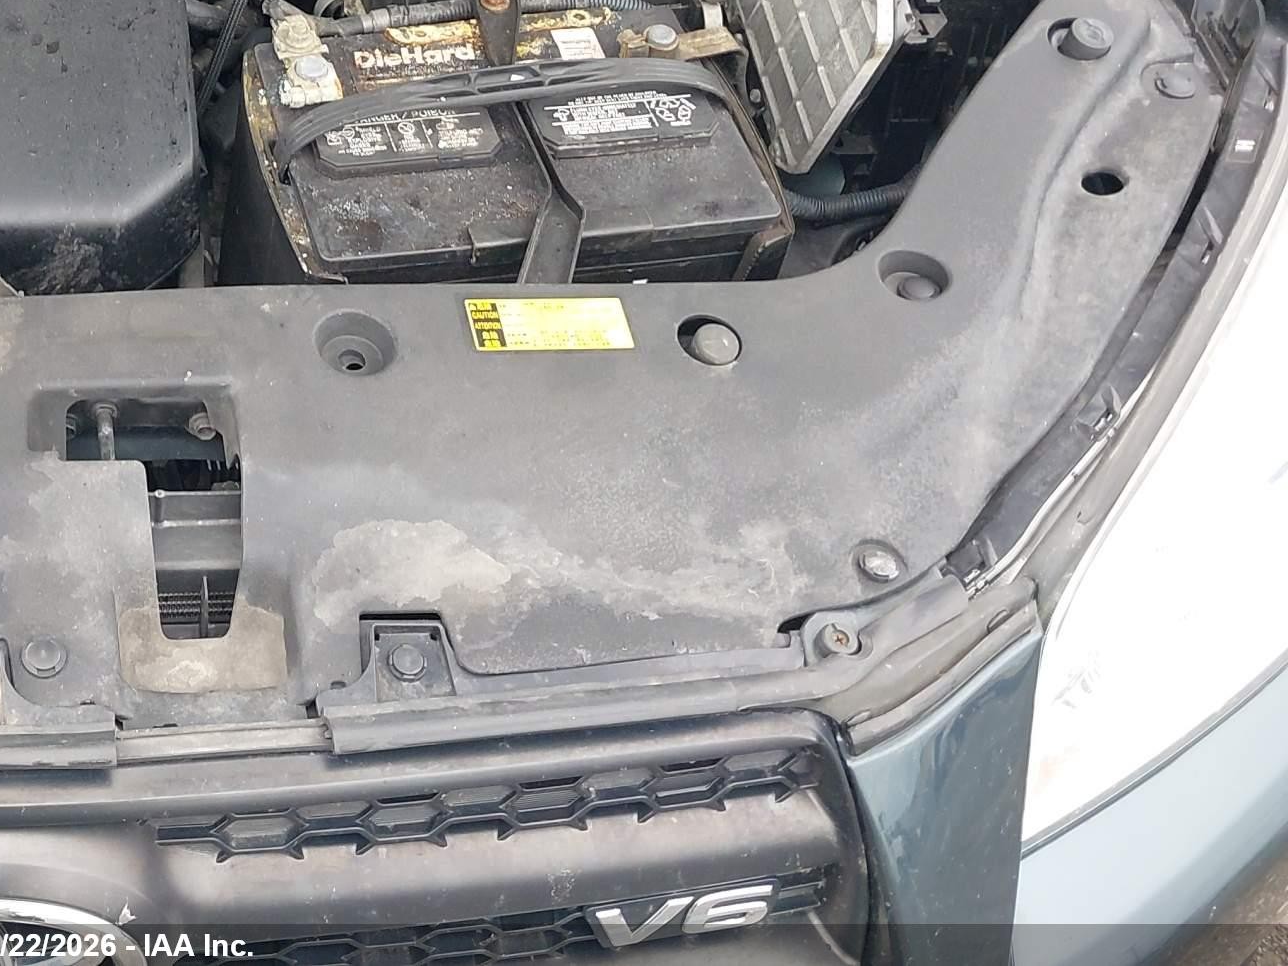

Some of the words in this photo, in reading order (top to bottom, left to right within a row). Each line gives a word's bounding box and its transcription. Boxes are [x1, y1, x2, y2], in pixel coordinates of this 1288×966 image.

[353, 43, 476, 68] DieHard
[471, 311, 500, 319] CAUTION
[596, 885, 773, 946] V6
